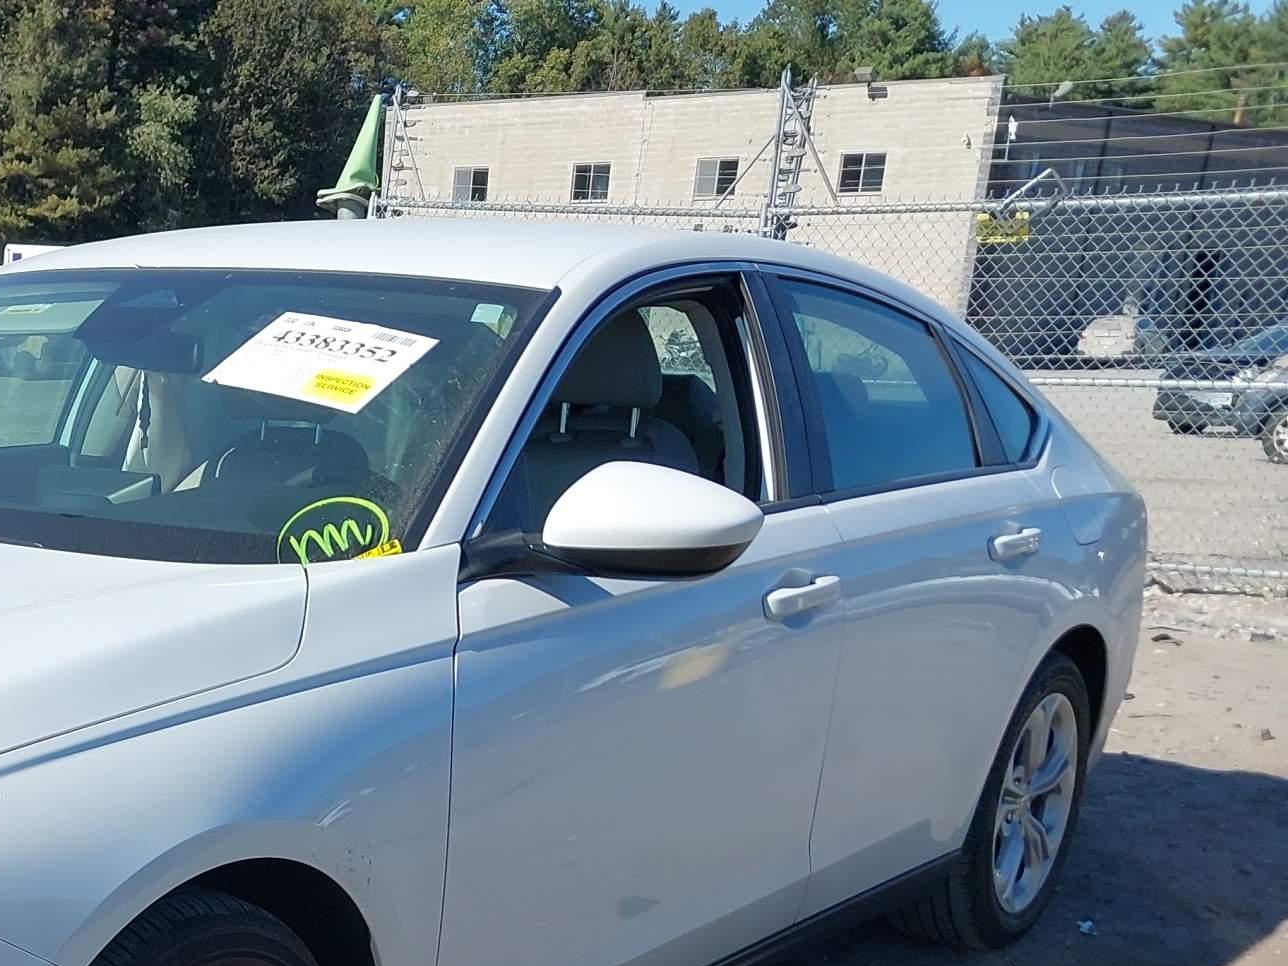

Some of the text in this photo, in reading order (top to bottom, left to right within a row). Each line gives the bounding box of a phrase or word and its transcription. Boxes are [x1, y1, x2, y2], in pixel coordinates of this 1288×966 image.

[273, 329, 397, 362] 43383352
[315, 382, 356, 394] SERVICE
[316, 374, 371, 390] INSPECTION
